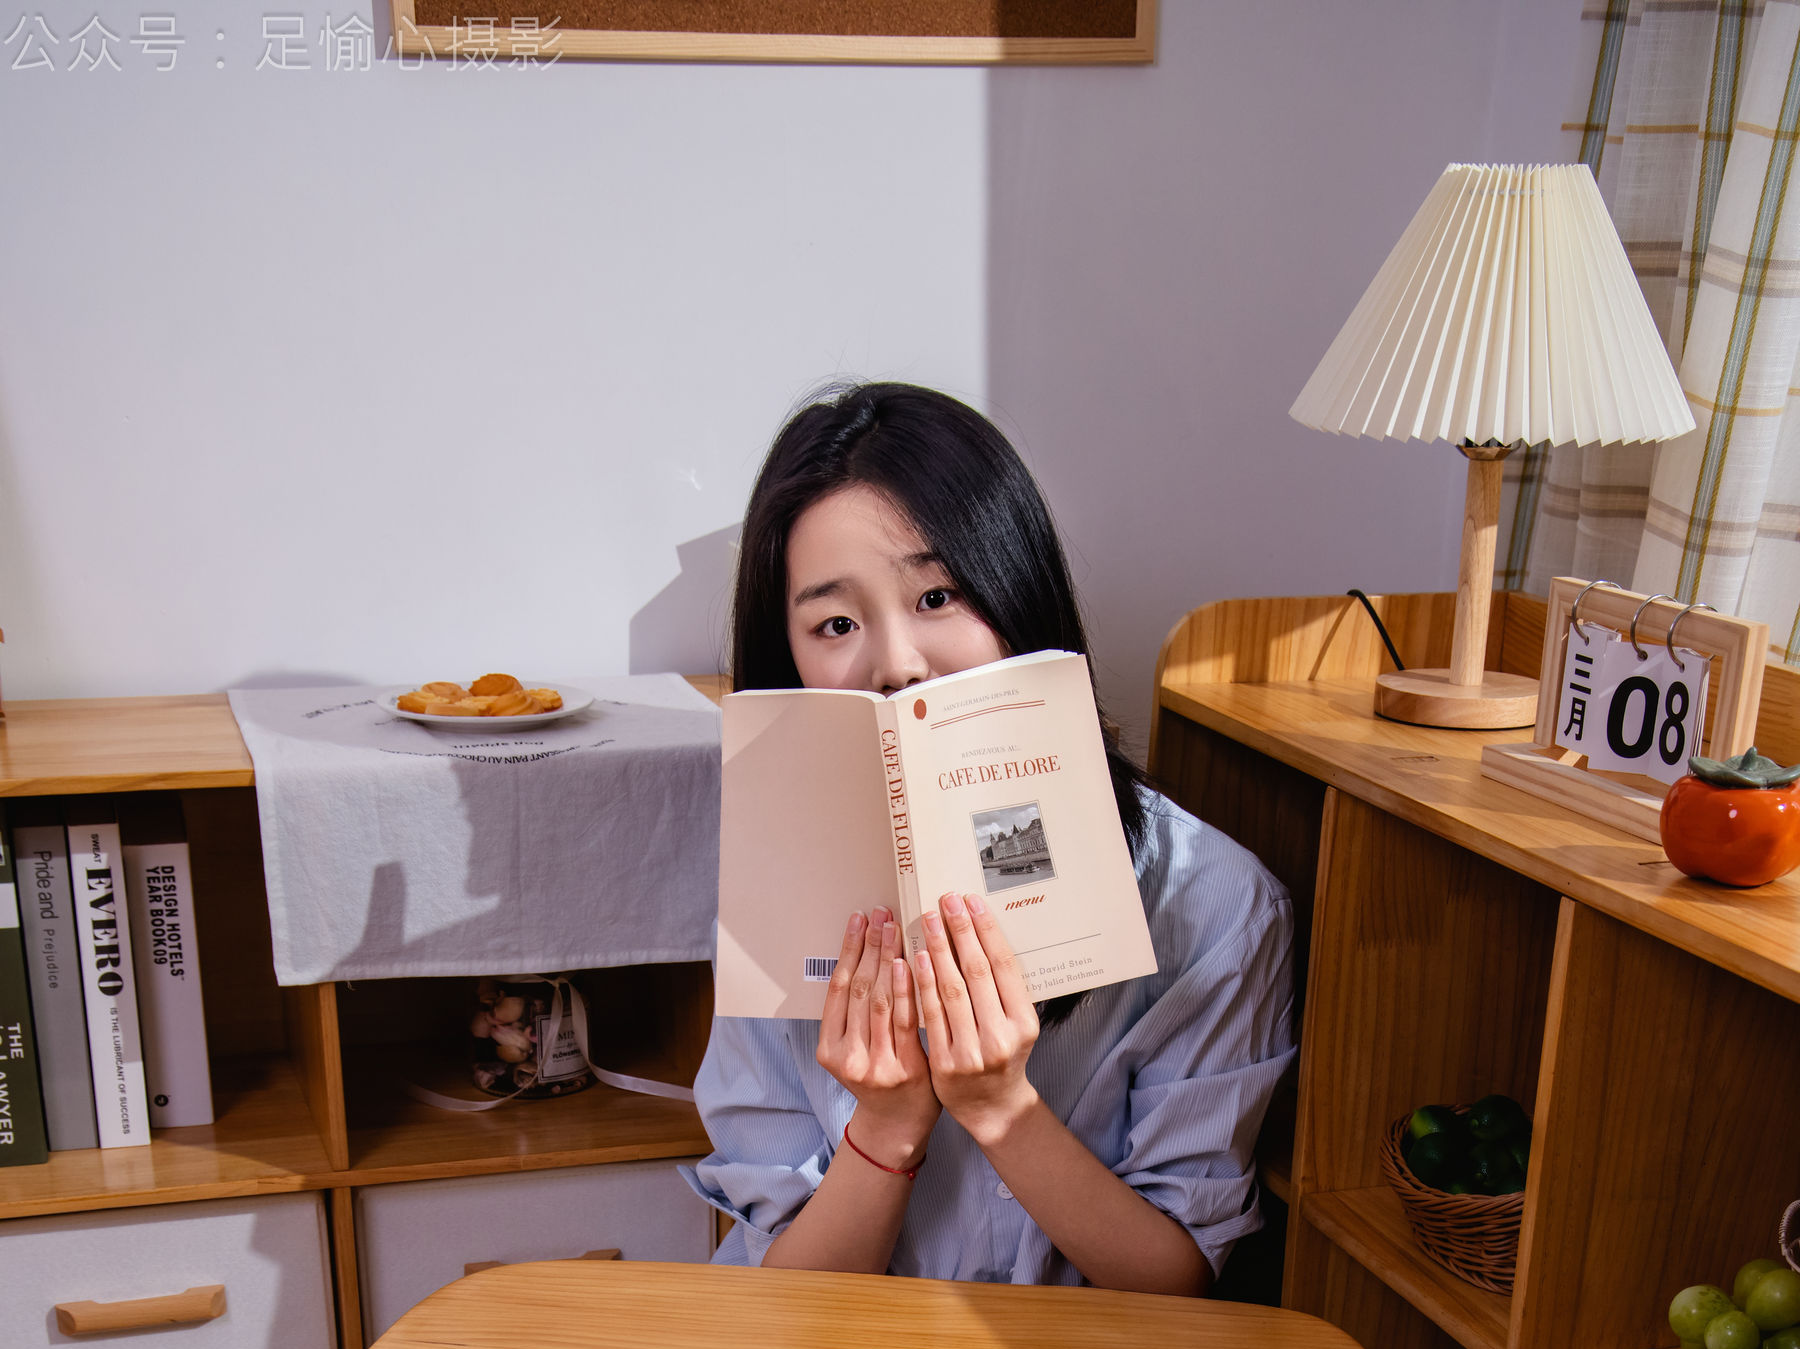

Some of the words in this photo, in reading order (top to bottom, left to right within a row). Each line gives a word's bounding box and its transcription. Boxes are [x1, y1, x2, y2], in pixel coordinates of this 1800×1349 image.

[1563, 652, 1594, 742] 三月
[1605, 675, 1691, 767] 08
[487, 756, 503, 764] AU
[504, 754, 529, 765] PAIN
[880, 729, 901, 775] CAFE
[938, 767, 977, 791] CAFE
[978, 764, 1002, 783] DE
[1004, 755, 1061, 779] FLORE
[888, 778, 905, 808] DE
[90, 833, 102, 863] SWEAT
[892, 813, 914, 875] FLORE
[33, 850, 55, 889] Pride
[145, 866, 163, 904] YEAR
[38, 891, 60, 920] and
[161, 865, 179, 918] DESIGN
[1005, 894, 1046, 911] menu
[85, 866, 123, 997] EVERO
[42, 928, 59, 989] Prejudice
[1039, 962, 1066, 976] David
[1069, 956, 1093, 968] Stein
[1044, 978, 1065, 989] Julia
[1066, 968, 1104, 983] Rothman
[8, 1022, 25, 1059] THE
[112, 1018, 120, 1033] THE
[113, 1035, 125, 1082] LUBRICANT
[118, 1084, 126, 1094] OF
[119, 1096, 131, 1135] SUCCESS
